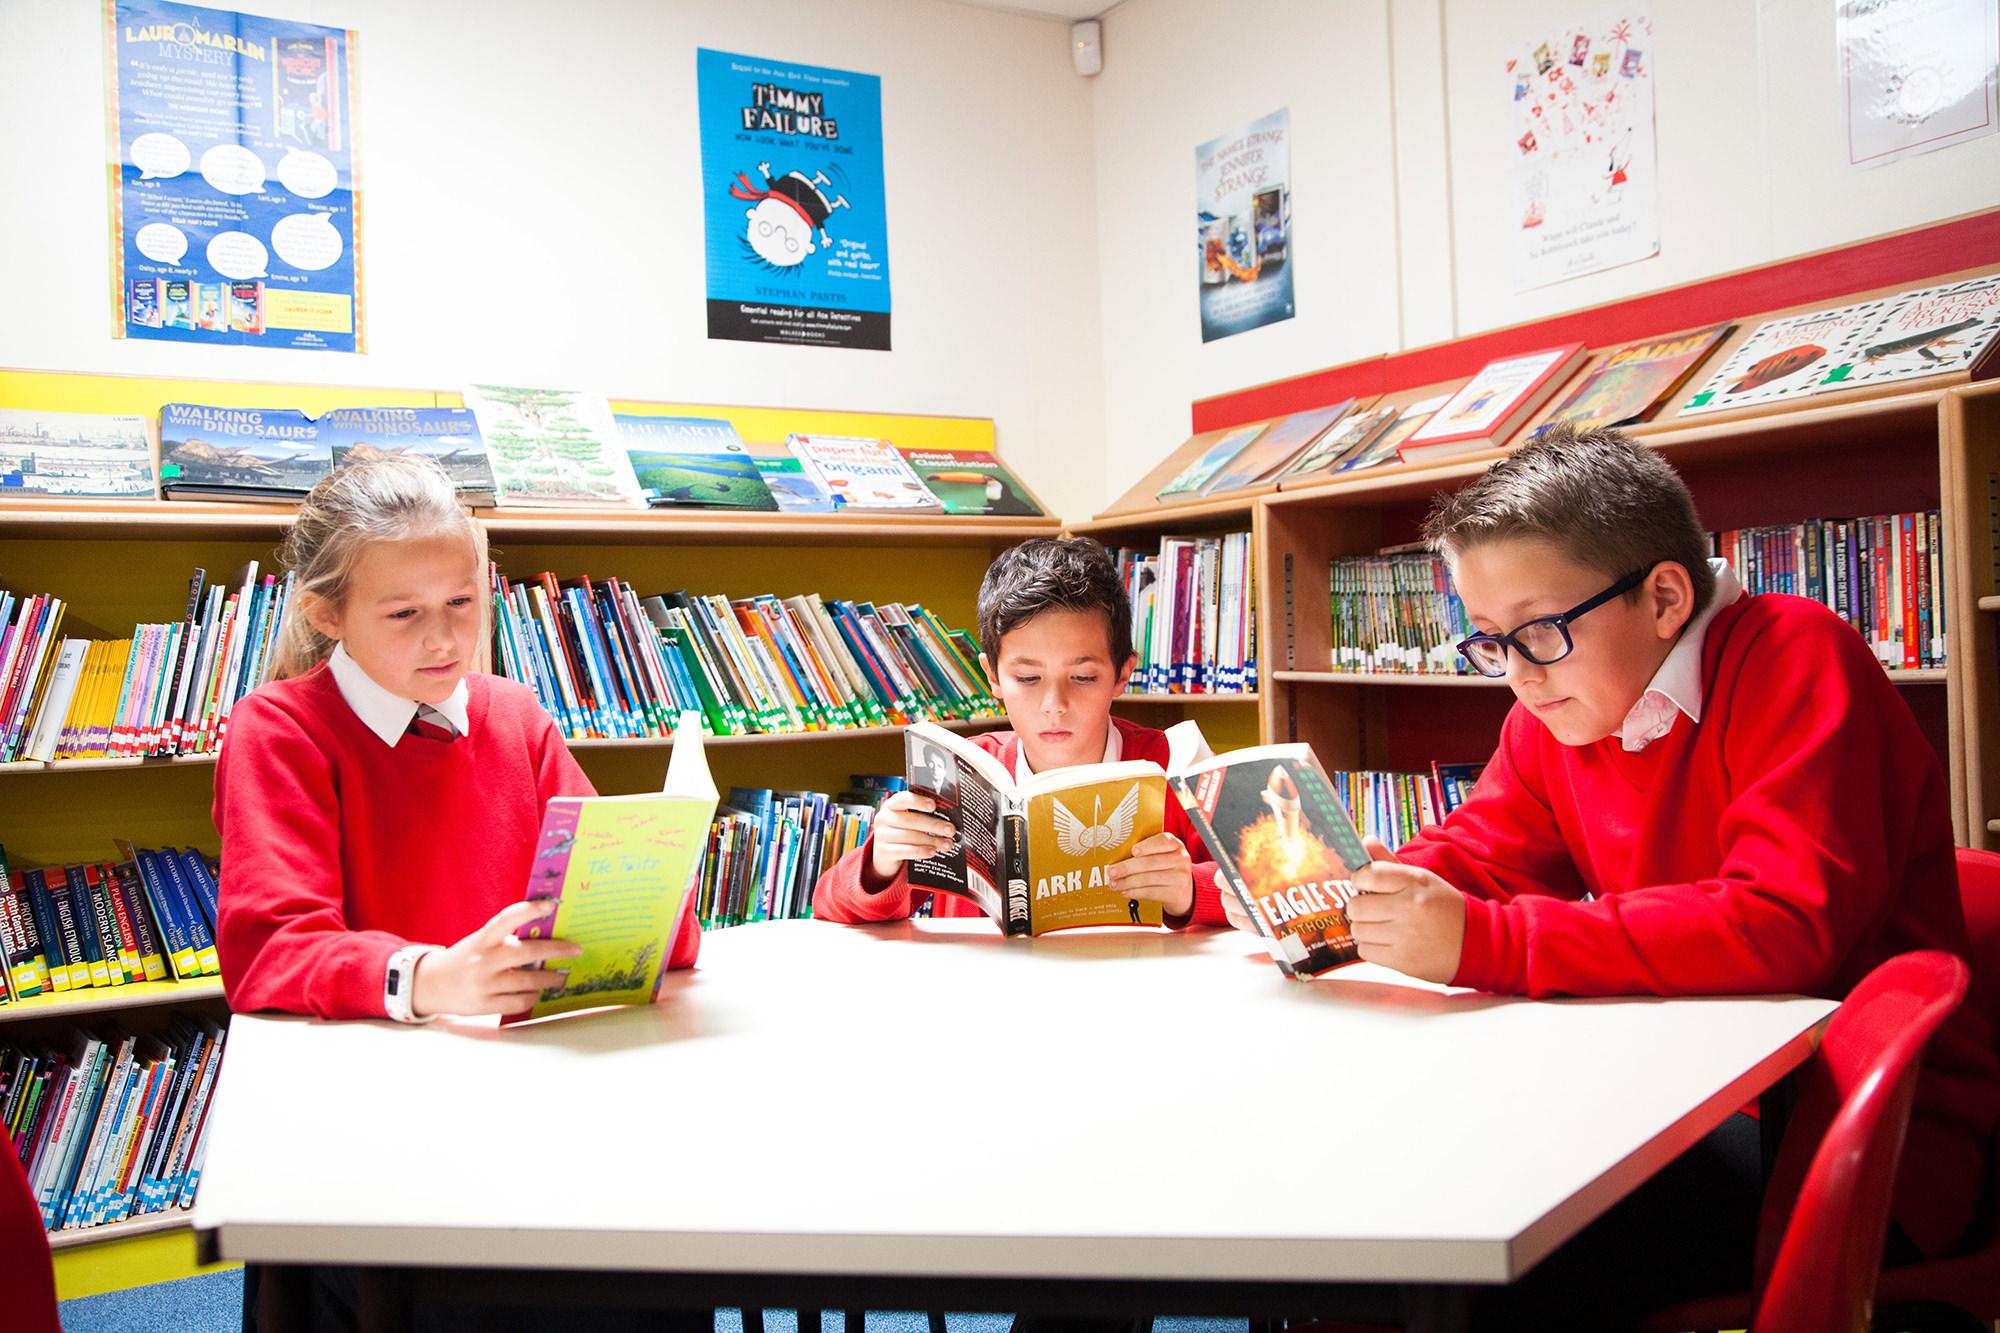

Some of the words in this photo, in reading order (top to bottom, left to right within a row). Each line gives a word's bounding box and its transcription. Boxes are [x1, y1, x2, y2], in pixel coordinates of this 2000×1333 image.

[159, 42, 234, 66] MYSTERY
[195, 31, 265, 62] MARLIN
[743, 108, 838, 139] FAILURE
[1215, 166, 1269, 202] STRANGE
[755, 287, 807, 300] STEPHAN
[810, 291, 848, 303] PASTIS
[740, 304, 768, 315] Essential
[769, 308, 793, 319] reading
[806, 310, 816, 319] all
[830, 311, 862, 322] Detectives
[170, 404, 262, 424] WALKING
[331, 409, 417, 423] WALKING
[169, 416, 201, 427] WITH
[203, 420, 320, 440] DINOSAURS
[333, 420, 363, 430] WITH
[365, 420, 474, 434] DINOSAURS
[664, 425, 735, 439] EARTH
[812, 445, 857, 456] paper
[861, 444, 888, 457] fun
[909, 451, 955, 461] Animal
[823, 461, 902, 477] origami
[914, 459, 999, 469] Classification
[1836, 554, 1847, 580] COSMIC
[1837, 582, 1848, 608] REMOTE
[170, 655, 184, 691] FUTURE
[186, 855, 205, 885] OXFORD
[914, 862, 931, 870] genuine
[941, 868, 957, 876] century
[922, 858, 937, 867] perfect
[143, 856, 160, 886] OXFORD
[154, 885, 165, 901] School
[164, 853, 181, 884] OXFORD
[175, 882, 185, 897] School
[1036, 869, 1083, 901] ARK
[109, 887, 125, 912] PLAIN
[1008, 879, 1028, 897] ARK
[6, 894, 19, 916] 20th
[56, 900, 73, 930] ENGLISH
[125, 886, 145, 924] RHYMING
[1258, 882, 1331, 927] EAGLE
[12, 914, 28, 950] Century
[90, 892, 112, 935] MODERN
[101, 933, 119, 963] SLANG
[102, 899, 123, 947] PUNCTUATION
[115, 910, 137, 947] ENGLISH
[195, 923, 208, 943] Word
[165, 927, 182, 953] Origins
[174, 927, 186, 946] Word
[187, 924, 204, 950] Origins
[1310, 941, 1327, 950] Rider
[85, 1051, 96, 1067] HOW
[77, 1067, 91, 1090] THINGS
[185, 1071, 196, 1090] Water
[71, 1090, 83, 1110] WORK
[50, 1119, 63, 1142] SCIENCE
